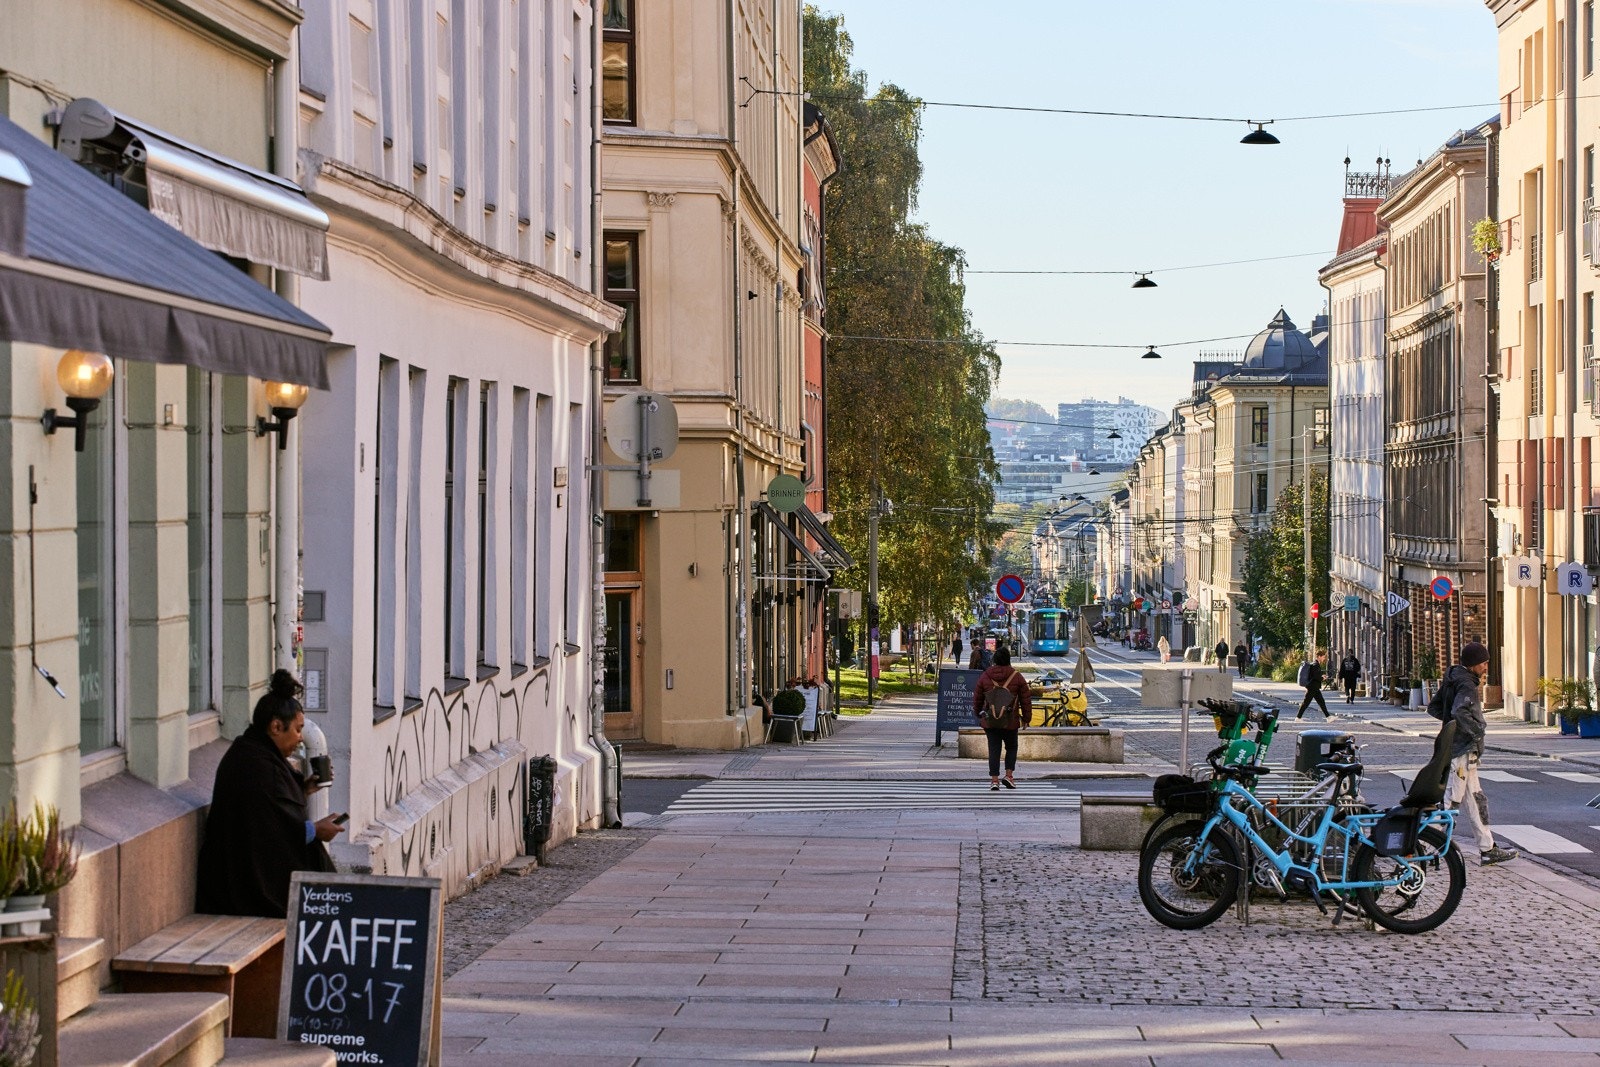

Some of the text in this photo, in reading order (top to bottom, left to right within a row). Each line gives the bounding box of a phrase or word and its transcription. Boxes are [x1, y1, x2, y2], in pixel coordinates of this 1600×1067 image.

[771, 489, 802, 498] BRINNER
[1519, 564, 1531, 580] R
[1568, 570, 1583, 587] R
[1389, 594, 1406, 614] BAR
[951, 683, 967, 691] HUSK
[1234, 749, 1247, 763] Bolt
[302, 886, 353, 903] Verdens
[302, 901, 340, 915] beste
[297, 917, 417, 971] KAFFE
[304, 972, 405, 1023] 08-17
[300, 1032, 365, 1046] supreme
[336, 1051, 384, 1065] works.
